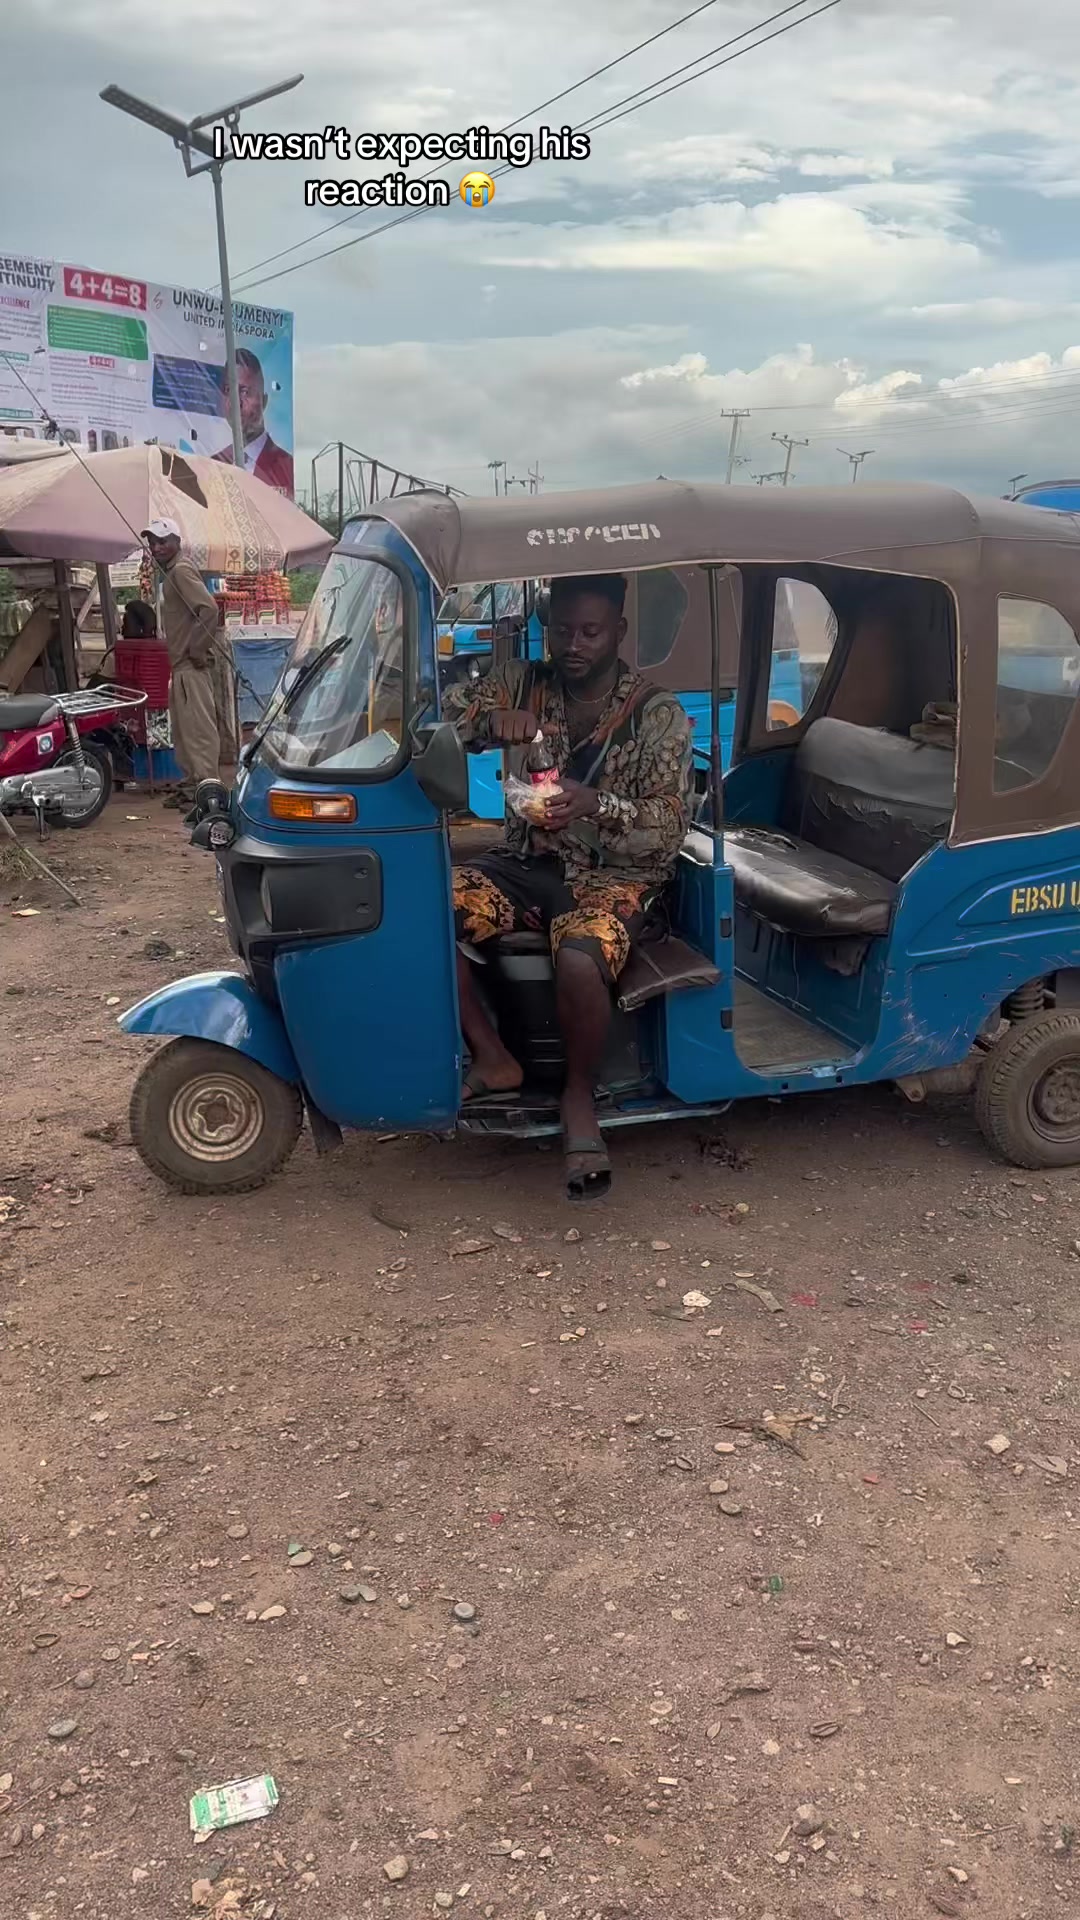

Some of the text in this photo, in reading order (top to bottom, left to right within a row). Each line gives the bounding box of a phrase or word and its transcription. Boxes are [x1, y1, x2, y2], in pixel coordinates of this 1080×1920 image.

[70, 273, 142, 306] 4+4=8
[183, 311, 215, 328] UNITED
[1011, 882, 1066, 915] EBSU
